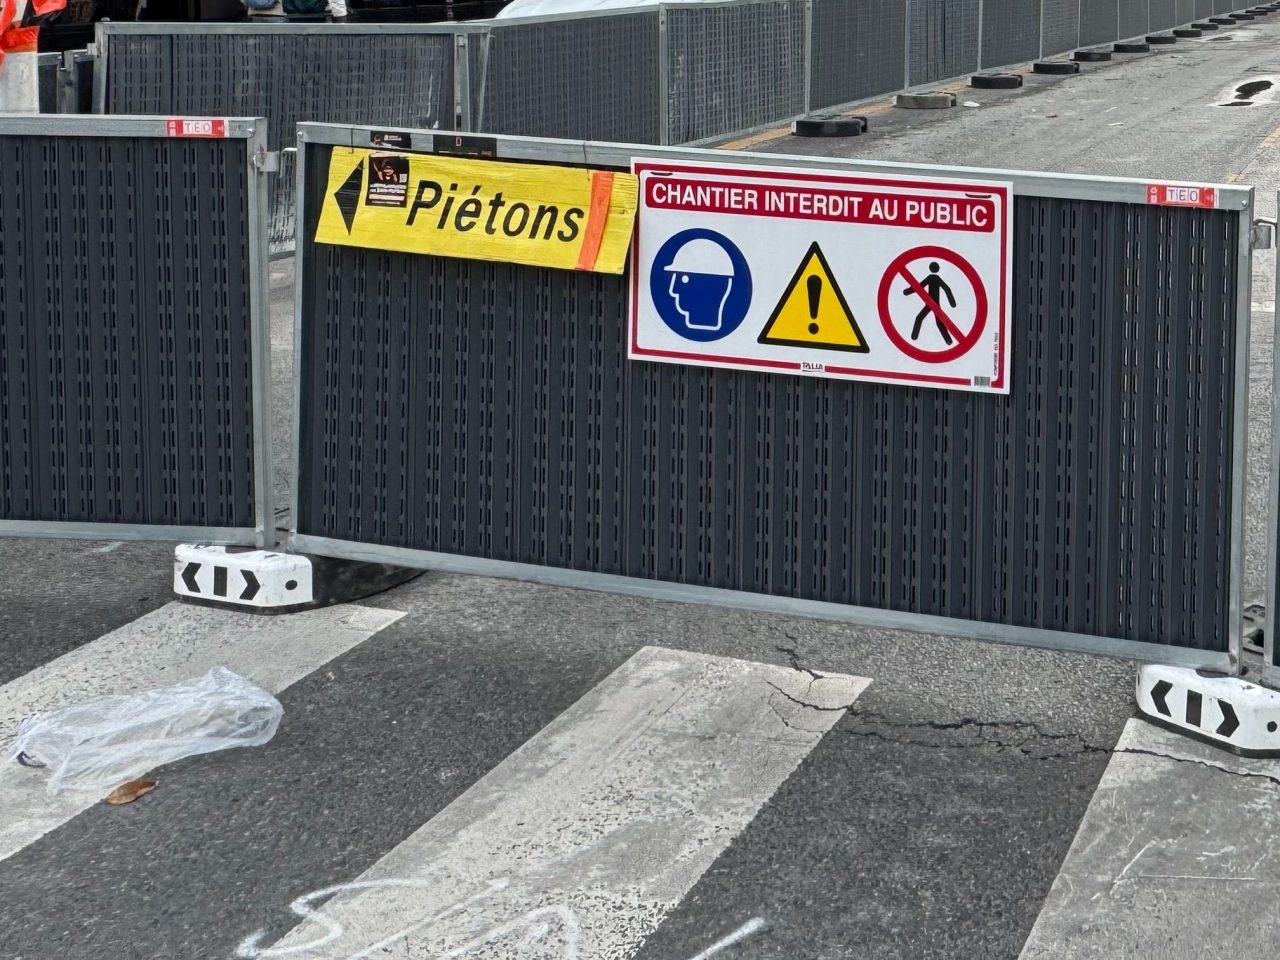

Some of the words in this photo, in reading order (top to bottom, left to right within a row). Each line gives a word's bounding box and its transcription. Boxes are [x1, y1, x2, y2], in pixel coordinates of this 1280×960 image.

[405, 179, 585, 243] Piétons
[652, 183, 758, 210] CHANTIER
[764, 190, 863, 217] INTERDIT
[868, 198, 899, 221] AU
[905, 200, 988, 227] PUBLIC
